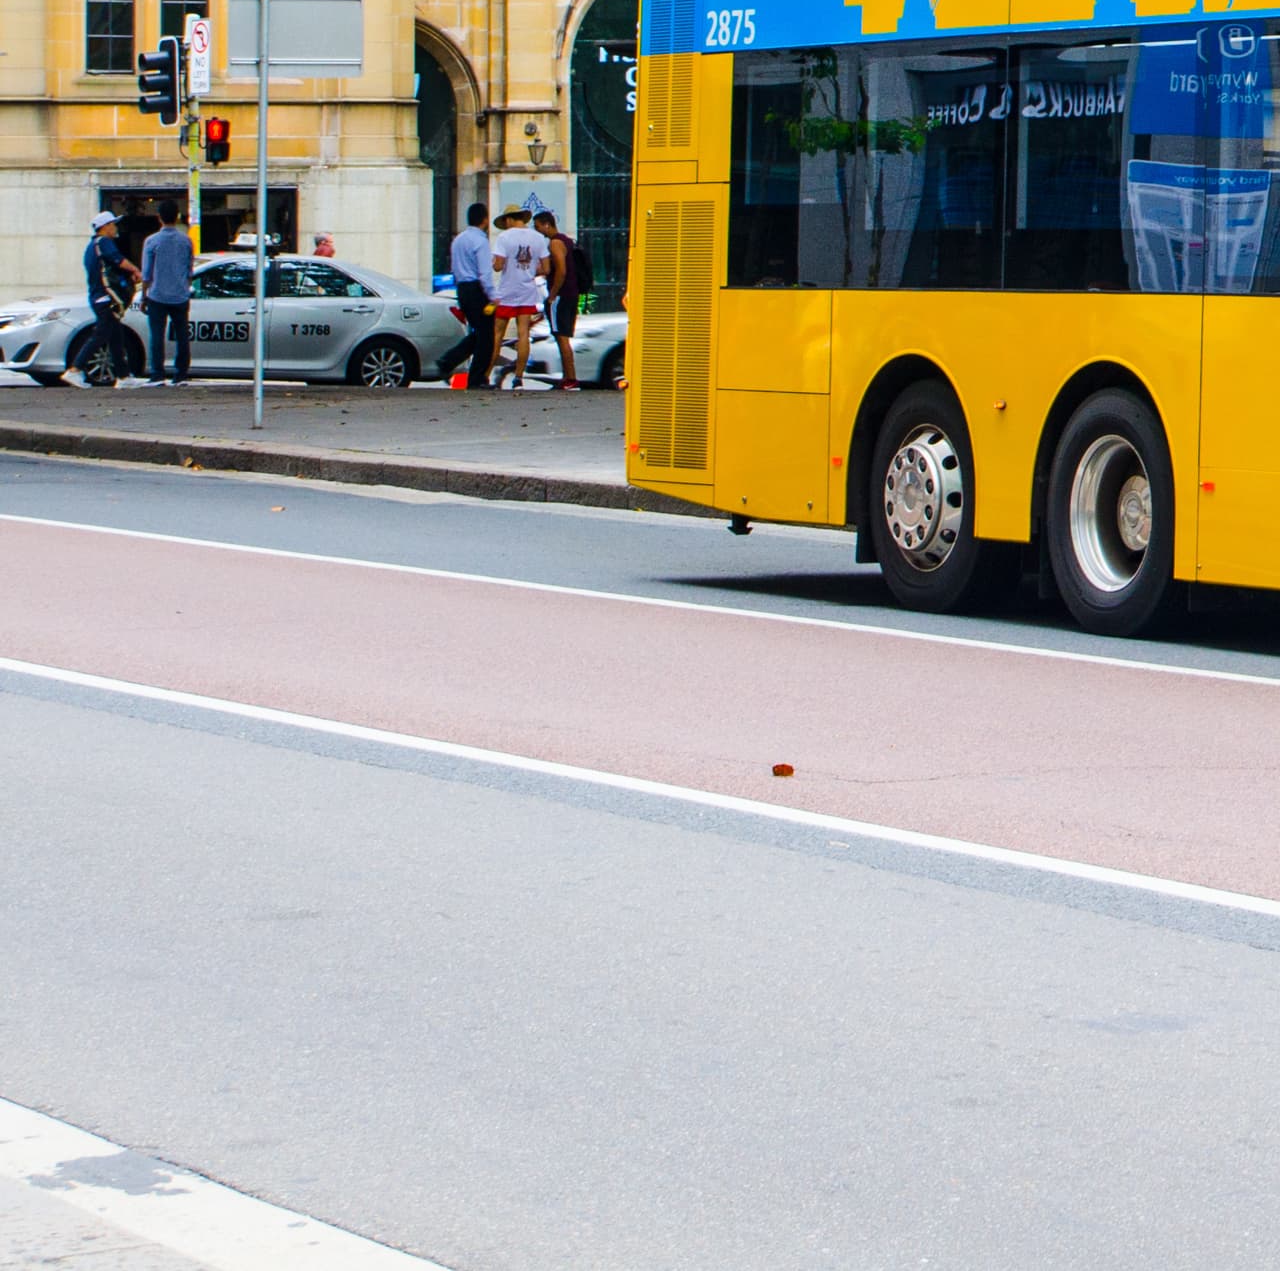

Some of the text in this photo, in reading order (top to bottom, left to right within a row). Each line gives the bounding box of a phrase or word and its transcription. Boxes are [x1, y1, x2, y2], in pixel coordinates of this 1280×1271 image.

[706, 8, 756, 47] 2875
[290, 324, 330, 336] T 3768
